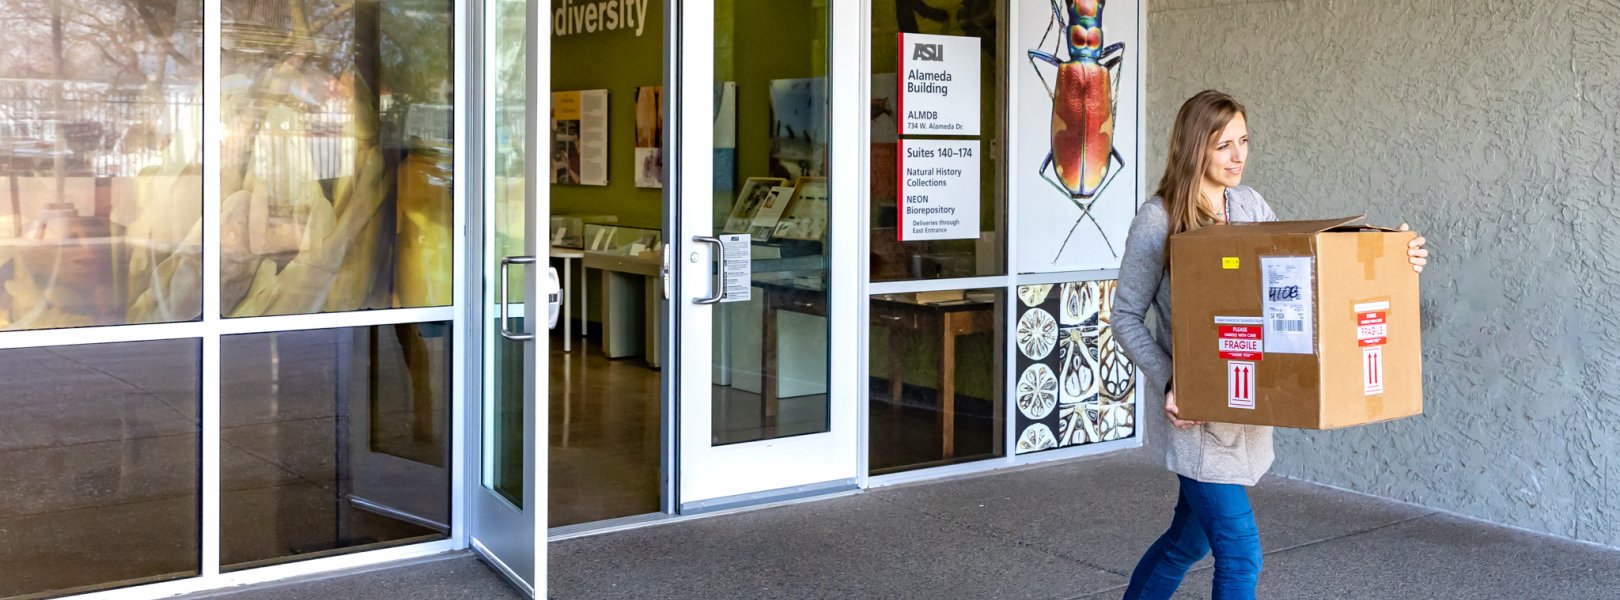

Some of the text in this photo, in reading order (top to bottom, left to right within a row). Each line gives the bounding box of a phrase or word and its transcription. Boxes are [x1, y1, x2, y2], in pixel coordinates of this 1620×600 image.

[551, 0, 648, 36] diversity
[913, 43, 943, 61] ASU
[908, 69, 952, 81] Alameda
[907, 82, 948, 97] Building
[908, 110, 938, 120] ALMDB
[907, 147, 935, 158] Suites
[906, 168, 962, 178] Natural History
[906, 178, 947, 187] Collections
[906, 195, 929, 203] NEON
[906, 205, 956, 216] Biorepository
[939, 219, 960, 227] through
[1224, 340, 1257, 350] FRAGILE
